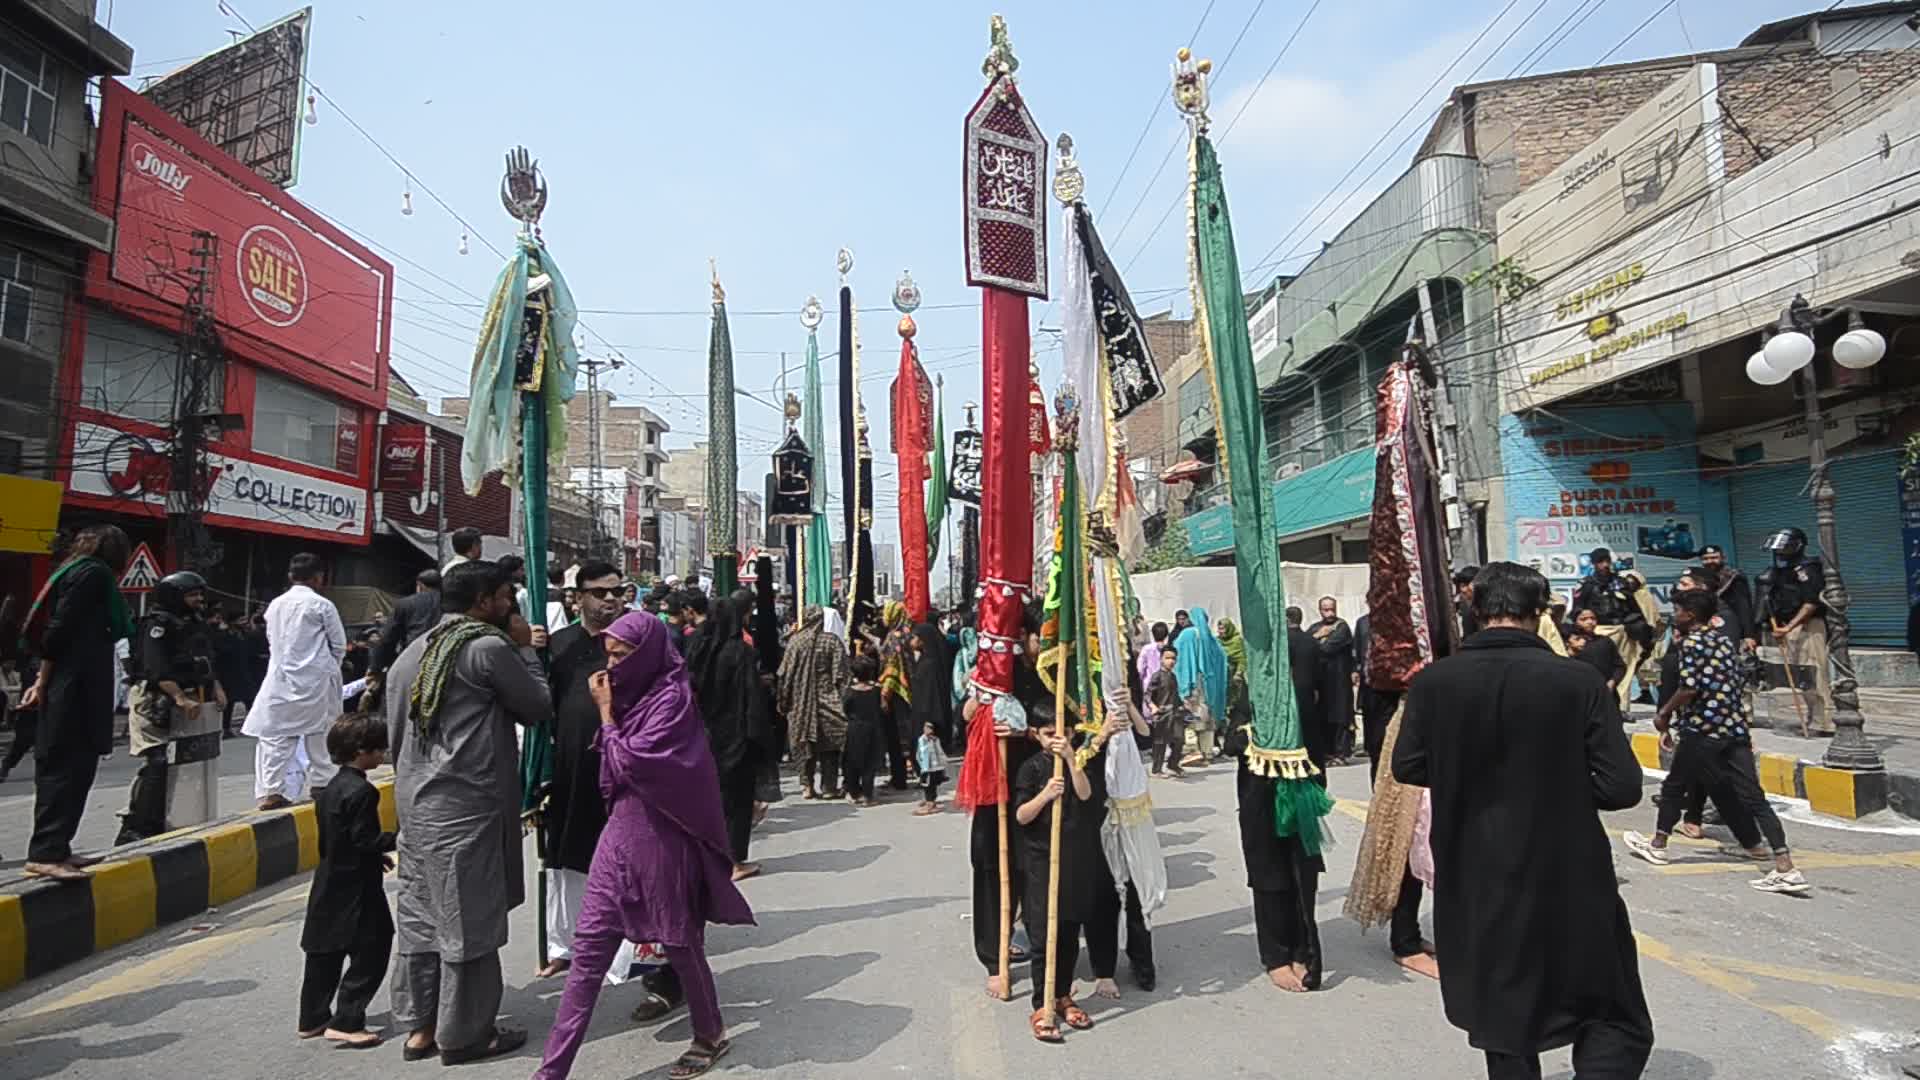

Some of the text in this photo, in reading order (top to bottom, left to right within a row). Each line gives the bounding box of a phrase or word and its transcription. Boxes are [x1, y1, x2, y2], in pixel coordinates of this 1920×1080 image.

[249, 247, 299, 303] SALE
[1556, 263, 1645, 321] SIEMENS
[234, 476, 357, 517] COLLECTION
